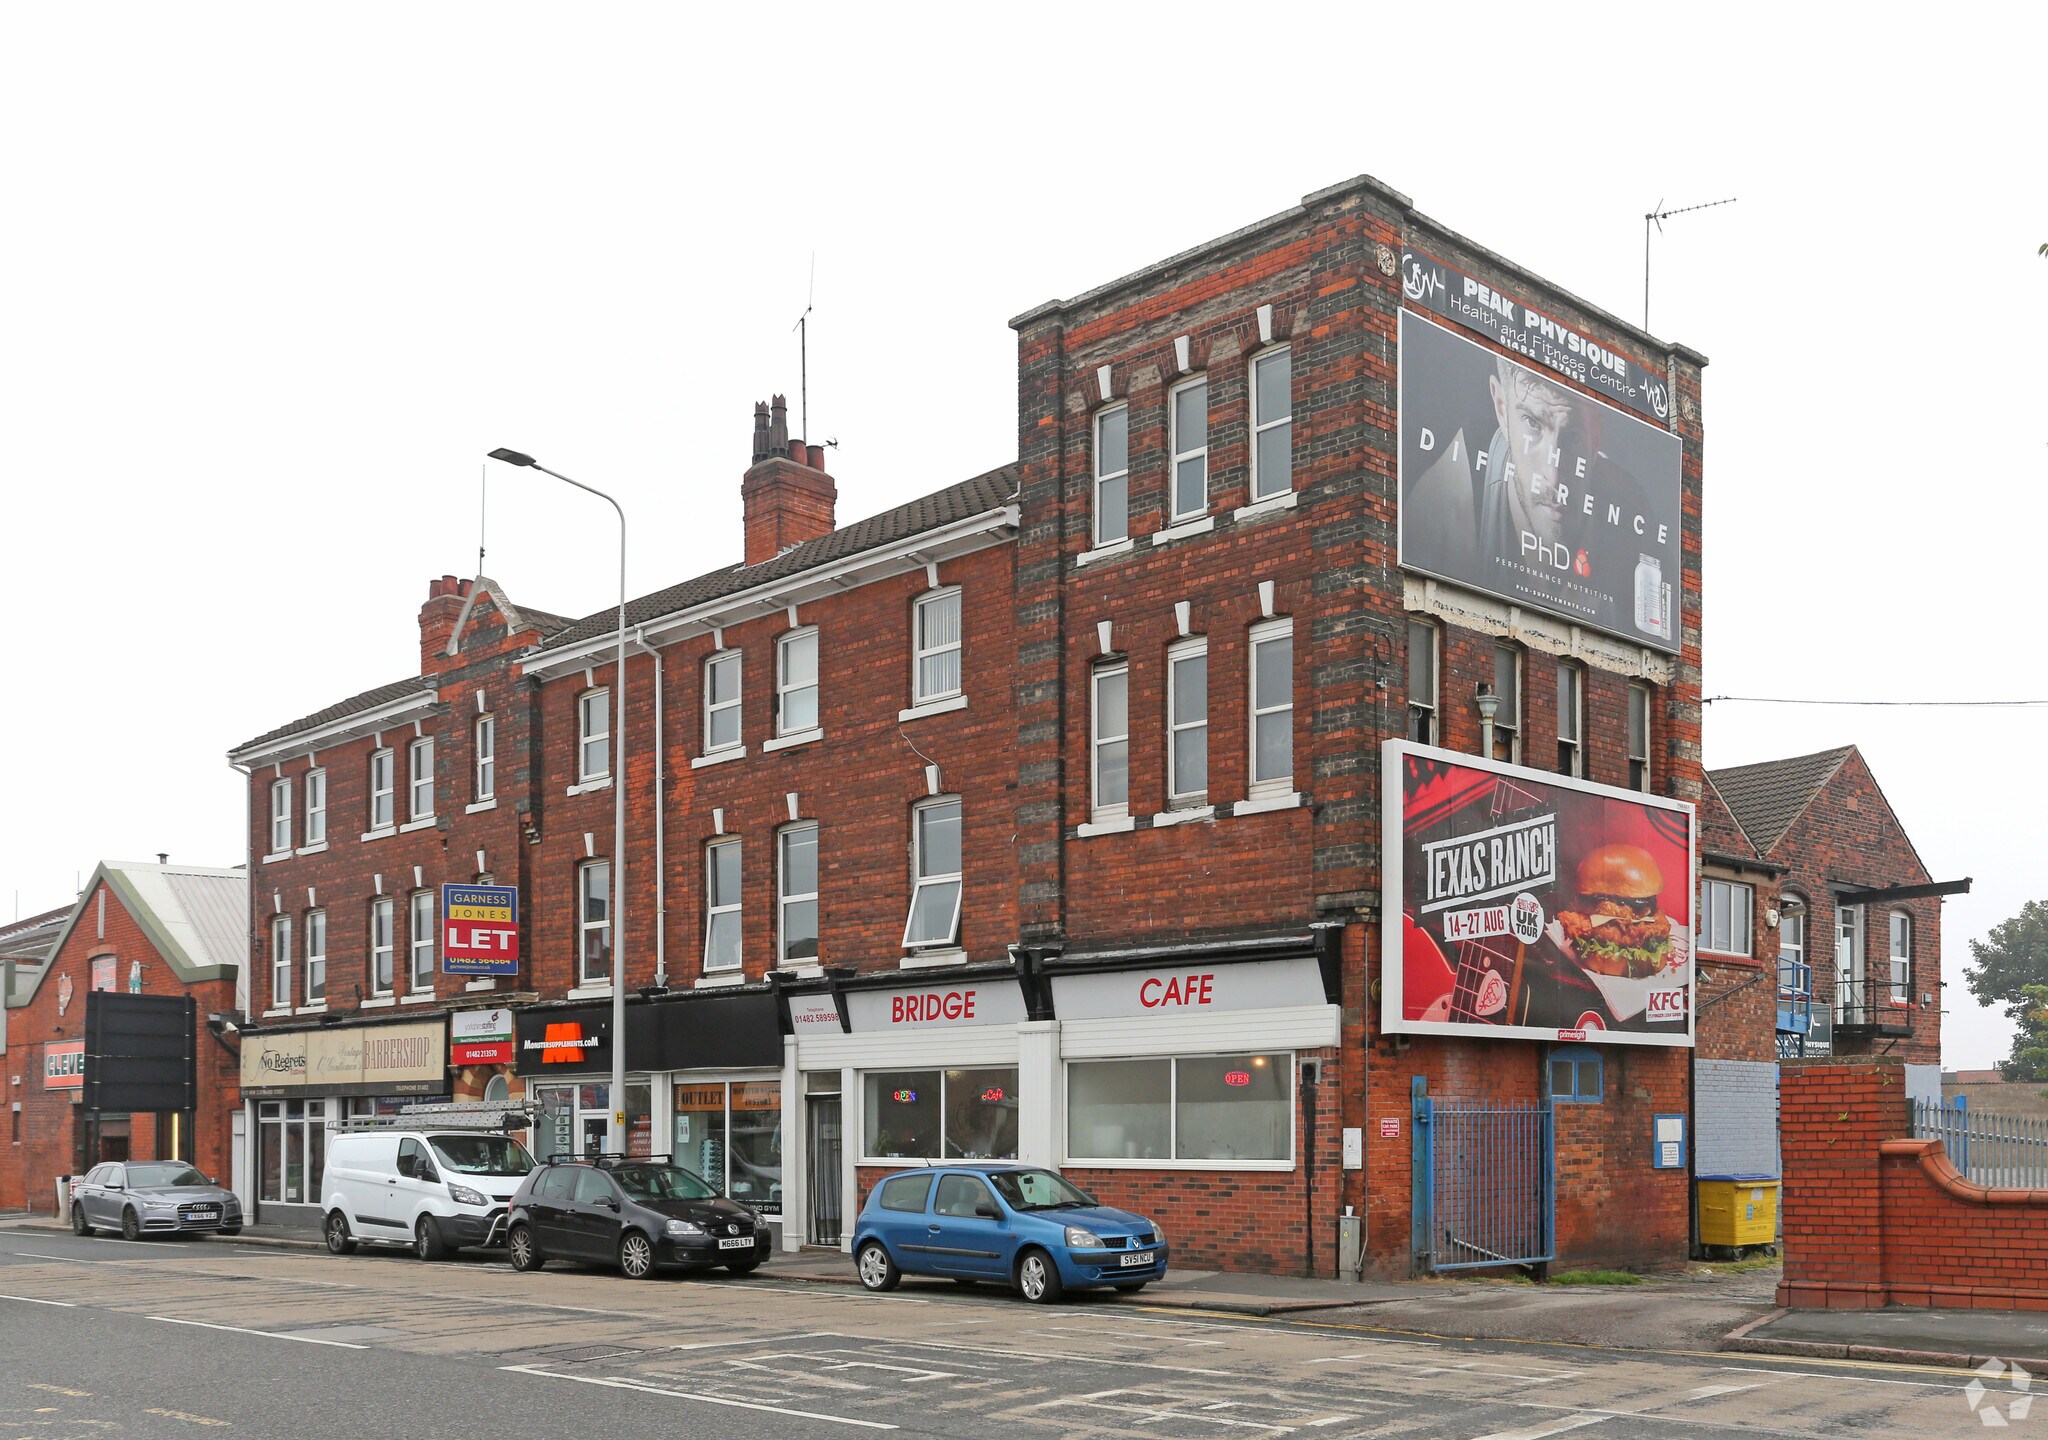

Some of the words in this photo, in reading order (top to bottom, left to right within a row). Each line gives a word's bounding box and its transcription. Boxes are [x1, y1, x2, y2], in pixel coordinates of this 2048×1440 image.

[1464, 276, 1515, 322] PEAK
[1525, 309, 1626, 377] PHYSIQUE
[1450, 294, 1498, 330] Health
[1500, 323, 1527, 344] and
[1532, 334, 1586, 373] Fitness
[1590, 366, 1636, 398] Centre
[1500, 335, 1536, 358] 01482
[1544, 356, 1586, 383] 327965
[1521, 434, 1587, 479] THE
[1419, 427, 1669, 545] DIFFERENCE
[1520, 529, 1570, 571] PhD
[1495, 556, 1562, 585] PERFORMANCE
[1567, 581, 1614, 603] NUTRITION
[1422, 842, 1486, 901] TEXAS
[1490, 823, 1556, 888] RANCH
[454, 893, 507, 905] GARNESS
[454, 909, 507, 919] JONES
[1484, 909, 1505, 933] AUG
[1515, 909, 1538, 927] UK
[449, 927, 516, 950] LET
[1515, 923, 1538, 938] TOUR
[1140, 974, 1215, 1008] CAFE
[1648, 991, 1681, 1011] KFC
[795, 1015, 814, 1023] 01482
[815, 1013, 839, 1022] 589598
[892, 991, 977, 1023] BRIDGE
[47, 1052, 85, 1077] CLEVE
[261, 1055, 273, 1070] No
[274, 1051, 306, 1072] Regrets
[364, 1037, 430, 1069] BARBERSHOP
[466, 1050, 480, 1058] 01482
[480, 1049, 498, 1058] 213570
[1225, 1074, 1250, 1084] OPEN
[682, 1091, 724, 1105] OUTLET
[893, 1089, 916, 1102] OPEN
[740, 1238, 752, 1247] LTY
[1124, 1255, 1139, 1264] SV51
[1139, 1253, 1151, 1262] NCU
